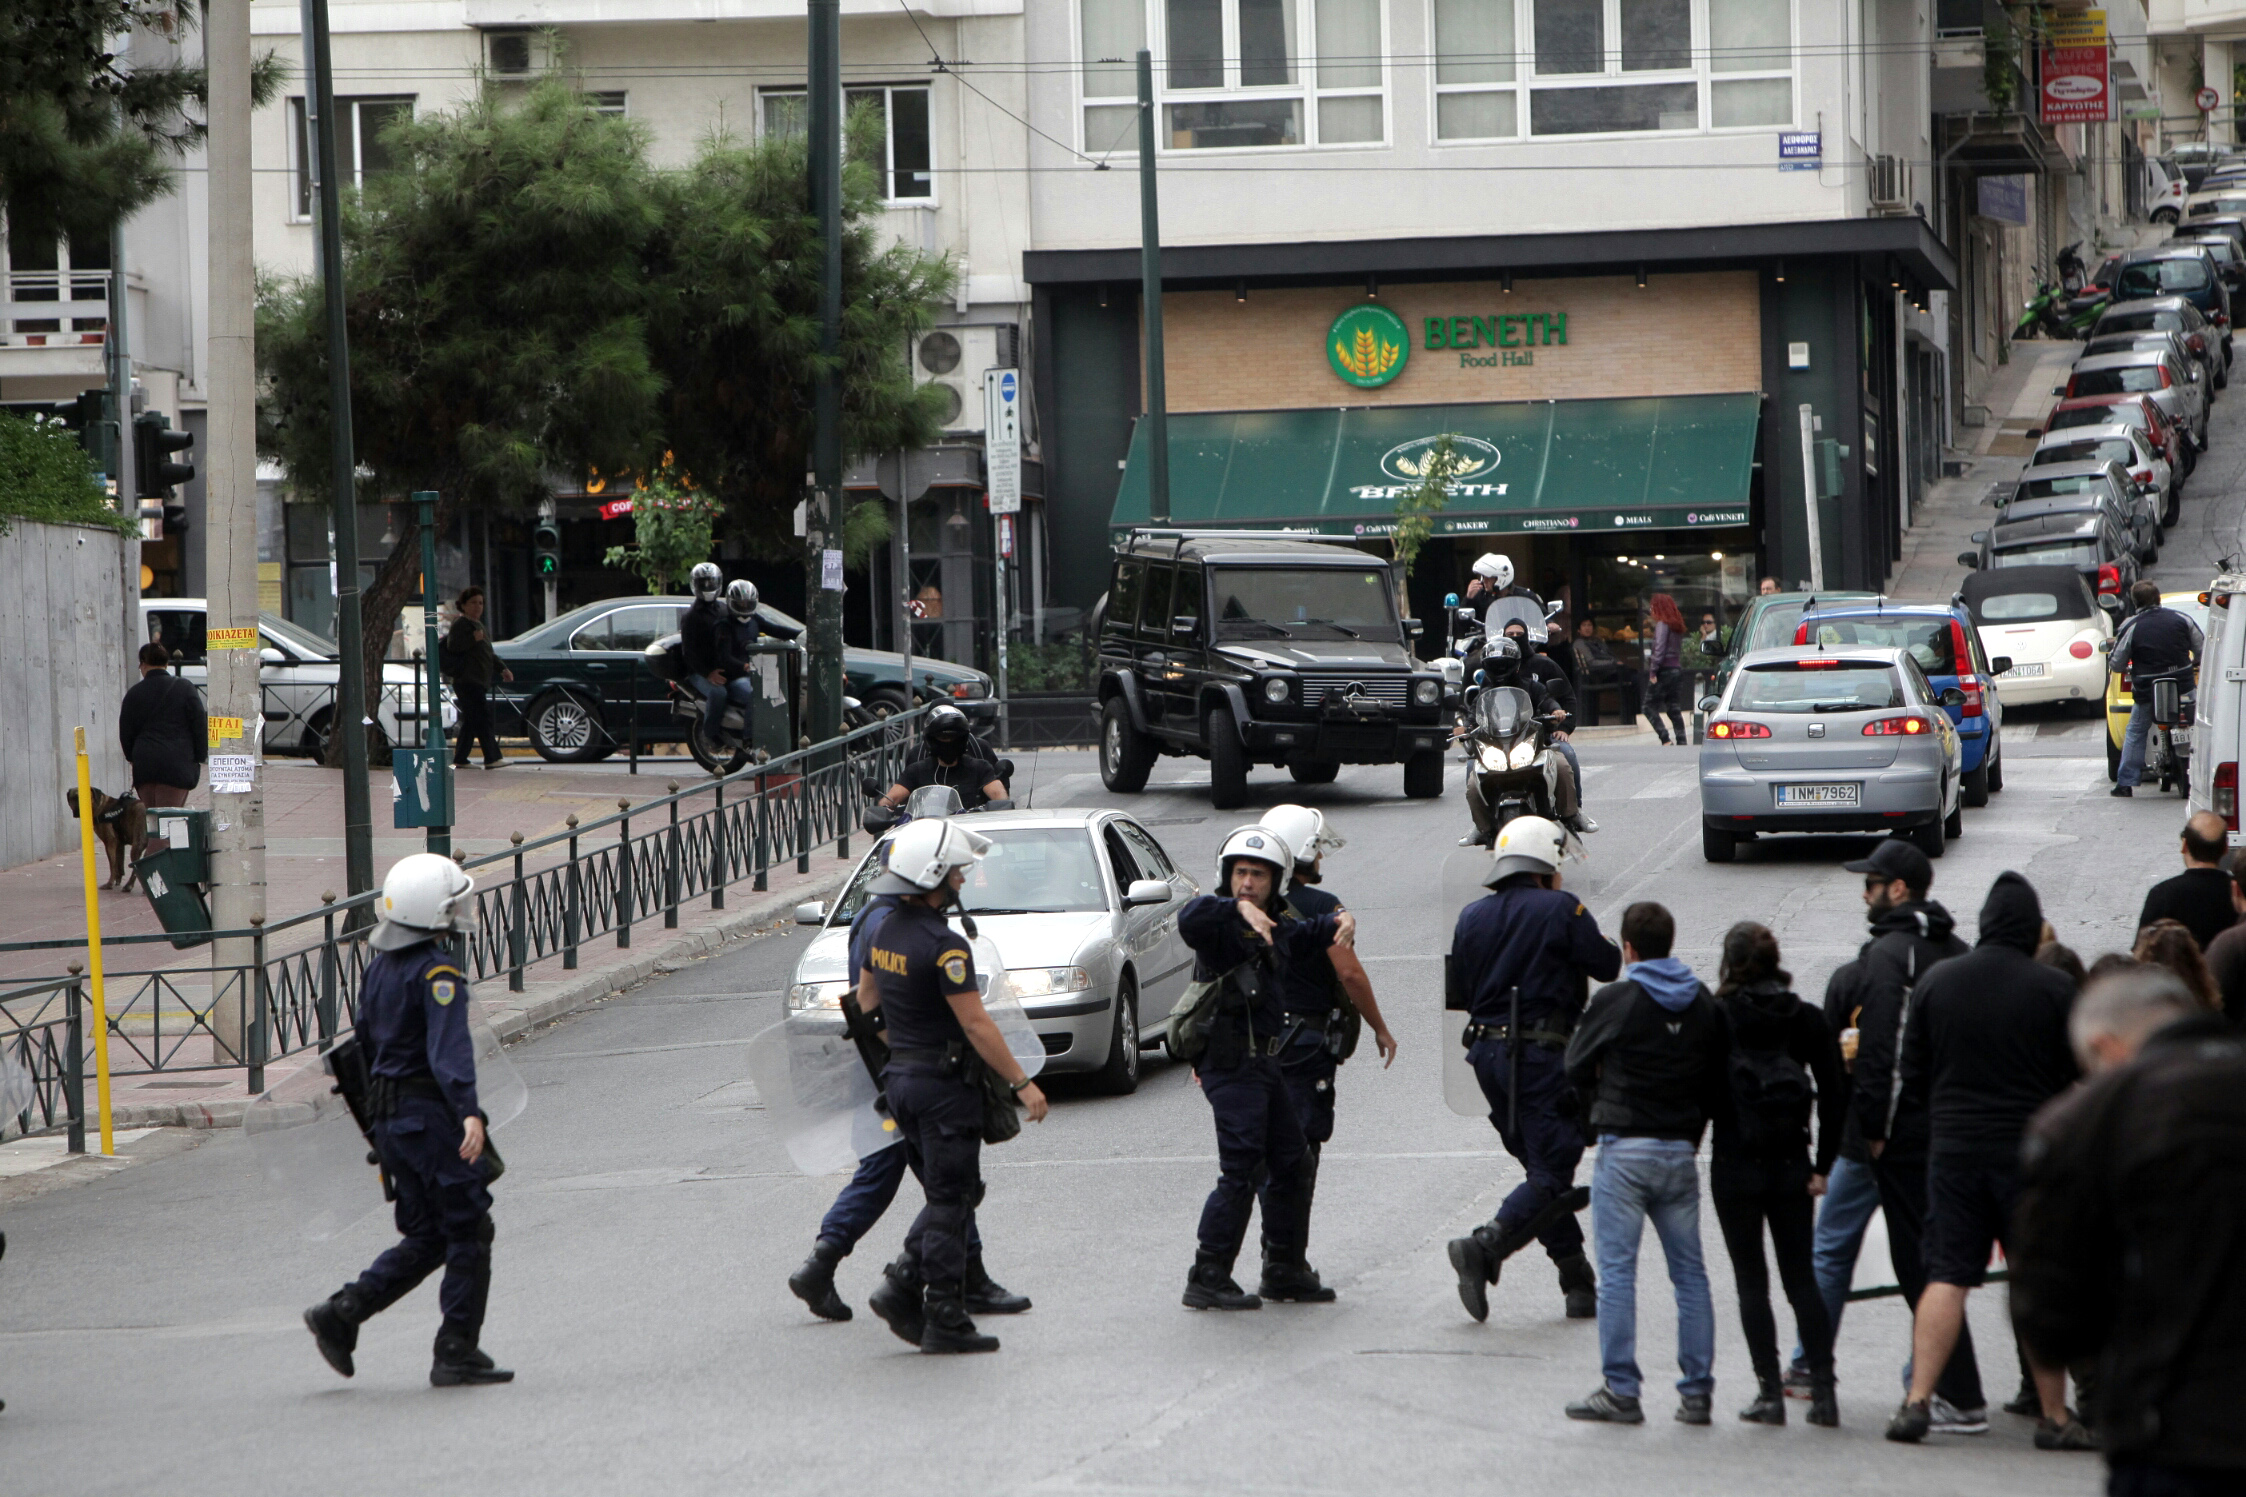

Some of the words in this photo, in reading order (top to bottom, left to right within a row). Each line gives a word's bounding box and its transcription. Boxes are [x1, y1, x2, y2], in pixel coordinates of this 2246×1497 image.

[2055, 49, 2095, 60] AUTO
[2044, 63, 2104, 76] SERVICE
[2045, 113, 2062, 122] 210
[1459, 352, 1498, 369] Food
[1501, 351, 1534, 367] Hall
[1456, 521, 1489, 530] BAKERY
[1523, 519, 1569, 528] CHRISTIANO
[1626, 515, 1652, 525] MEALS
[207, 628, 255, 640] ΟΙΚΙΑΖΕΤΑΙ
[213, 757, 246, 765] ΕΠΕΙΓΟΝ
[1821, 786, 1855, 799] 7962
[871, 946, 908, 976] POLICE
